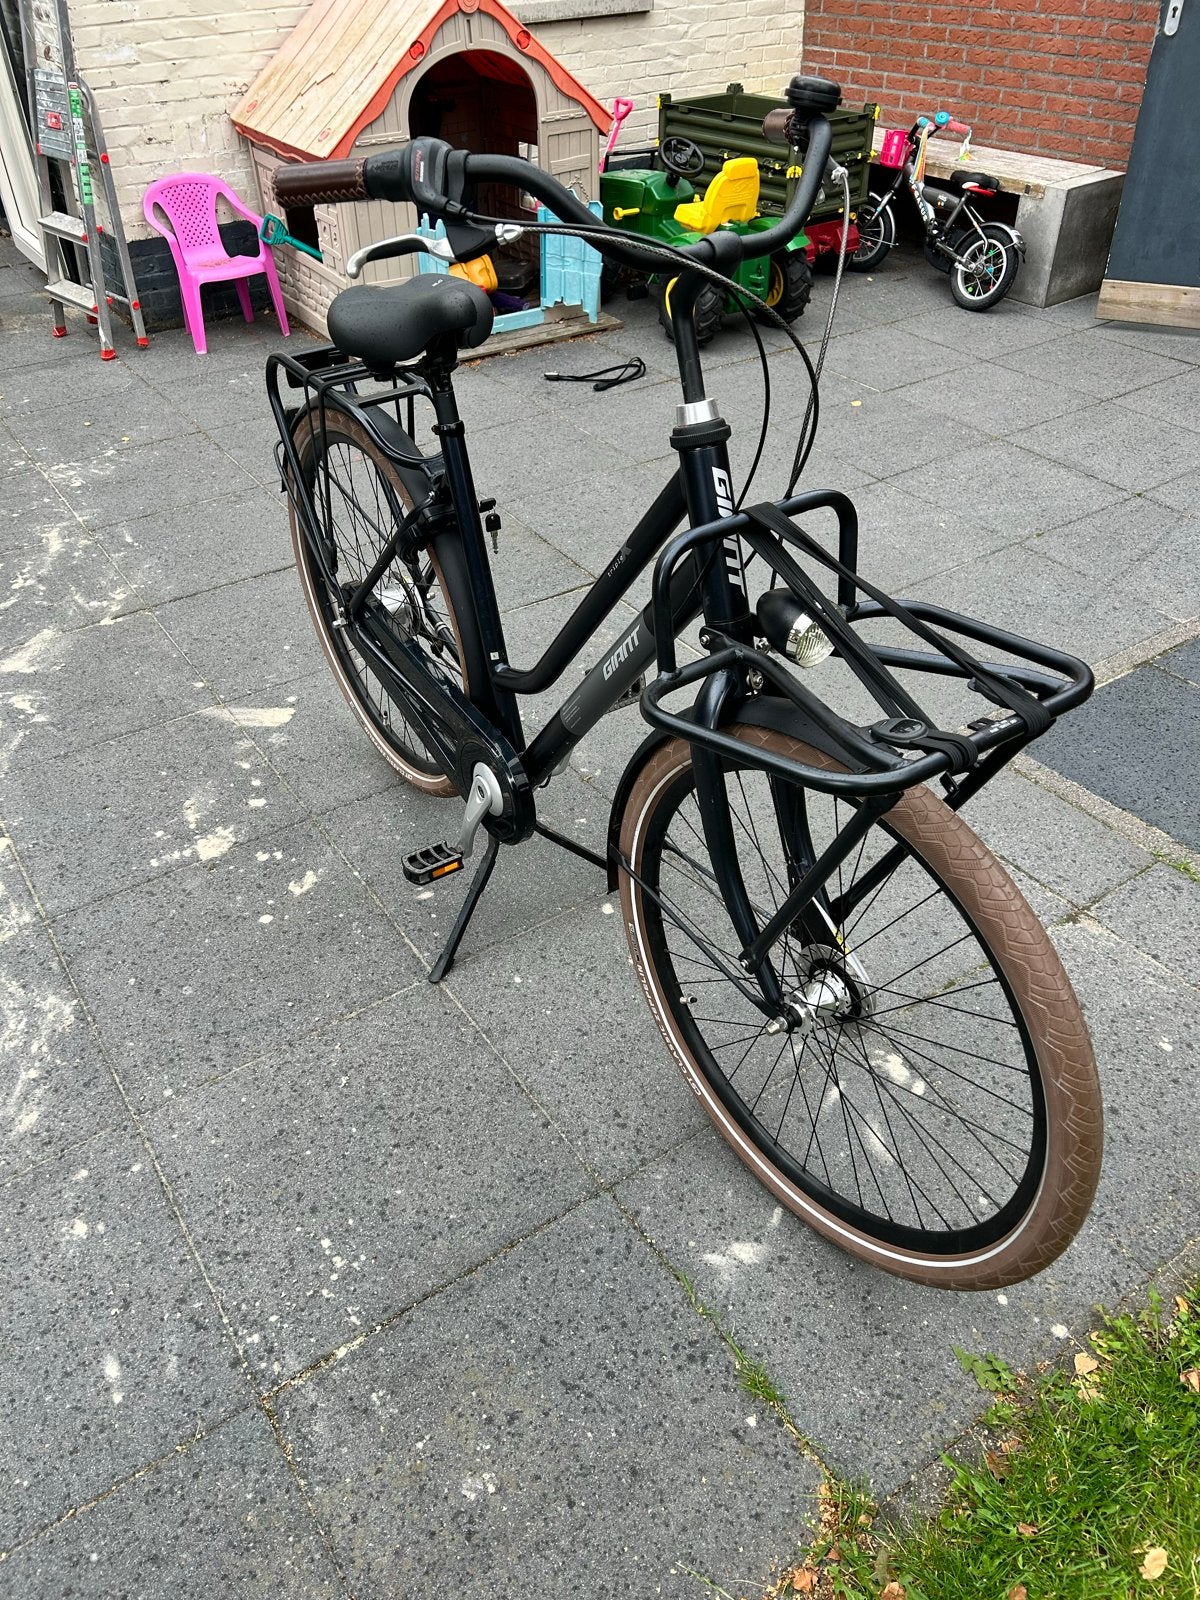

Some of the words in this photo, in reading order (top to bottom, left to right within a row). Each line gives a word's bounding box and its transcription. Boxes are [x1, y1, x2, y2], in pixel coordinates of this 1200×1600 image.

[602, 624, 641, 681] GIANT
[636, 964, 661, 1022] ZEPPELIN
[659, 1023, 688, 1075] CLASSIC
[687, 1074, 702, 1096] CST
